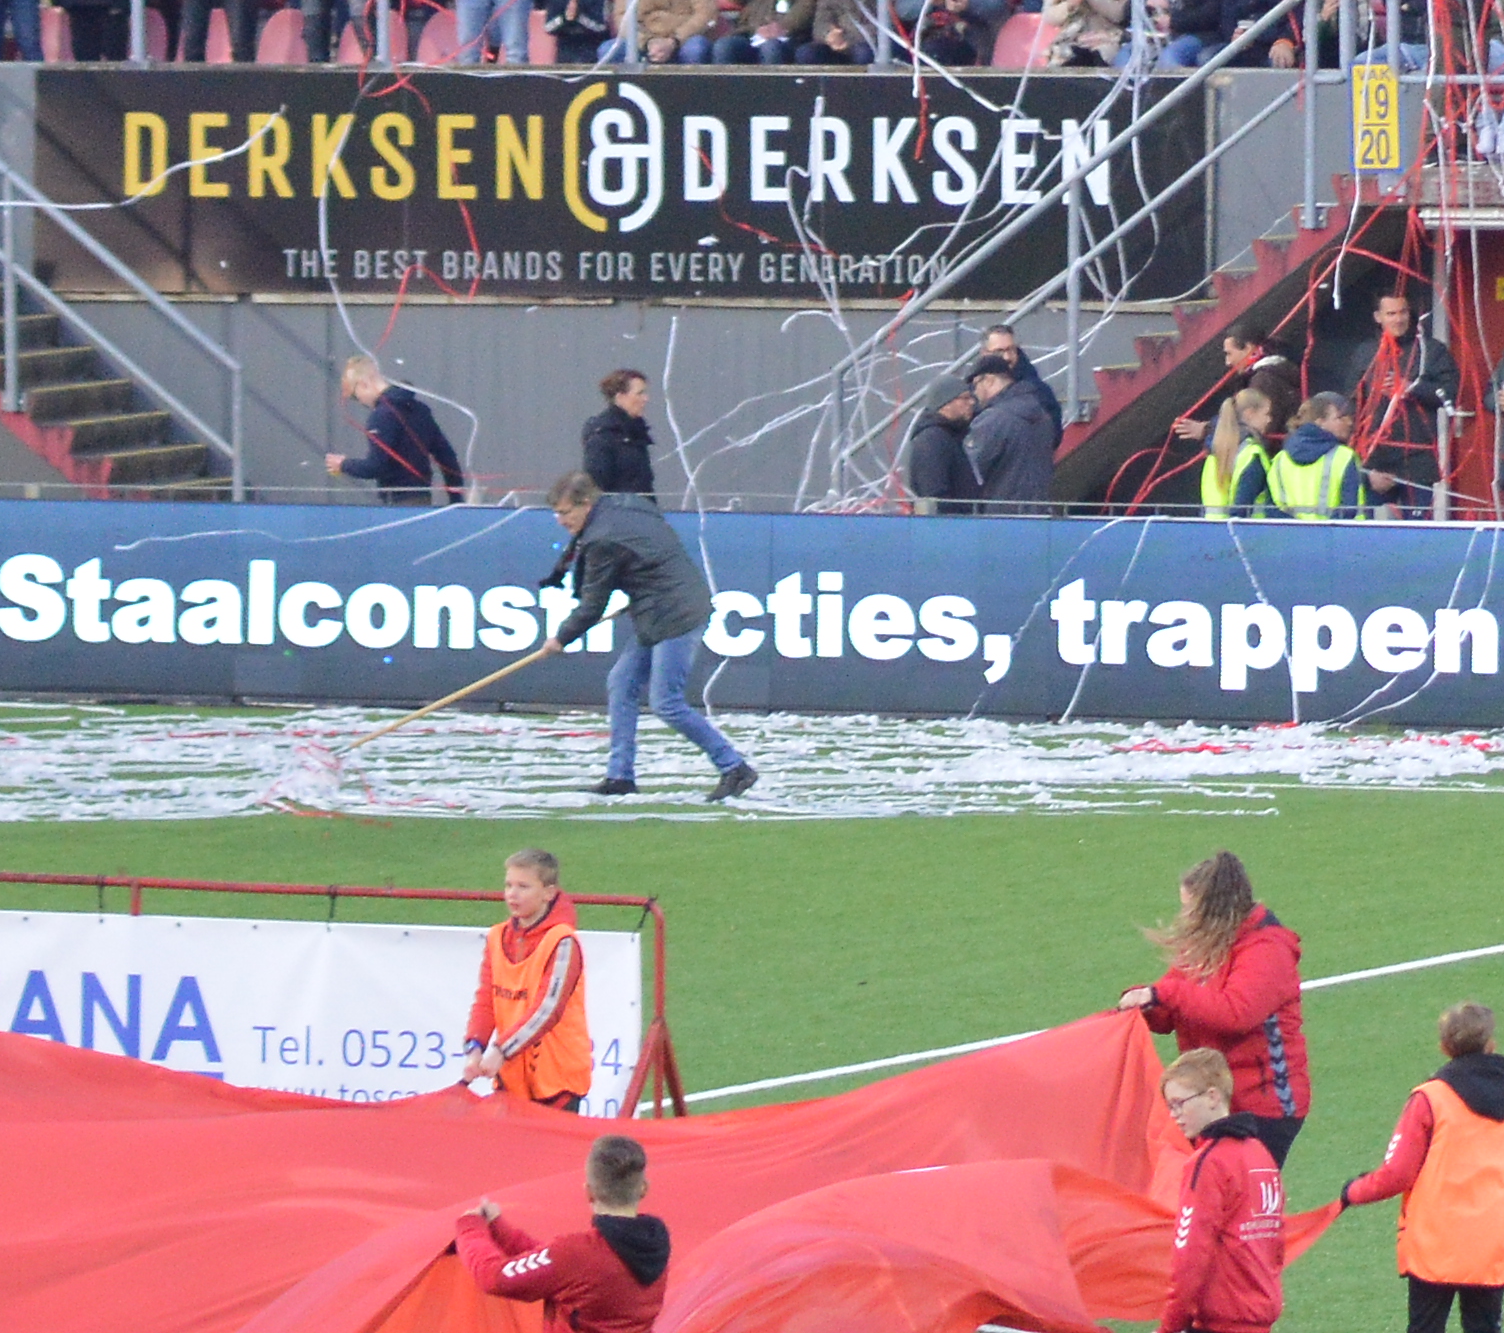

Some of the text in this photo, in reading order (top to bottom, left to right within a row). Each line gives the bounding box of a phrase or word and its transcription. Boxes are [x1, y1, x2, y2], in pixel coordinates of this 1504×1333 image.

[1361, 84, 1390, 120] 19
[123, 112, 544, 200] DERKSEN
[683, 116, 1109, 205] DERKSEN
[1360, 128, 1391, 165] 20
[284, 248, 341, 282] THE
[351, 249, 431, 283] BEST
[446, 250, 563, 284] BRANDS
[579, 251, 635, 284] FOR
[651, 251, 743, 285] EVERY
[1051, 579, 1496, 691] trappen
[253, 1026, 324, 1066] Tel.
